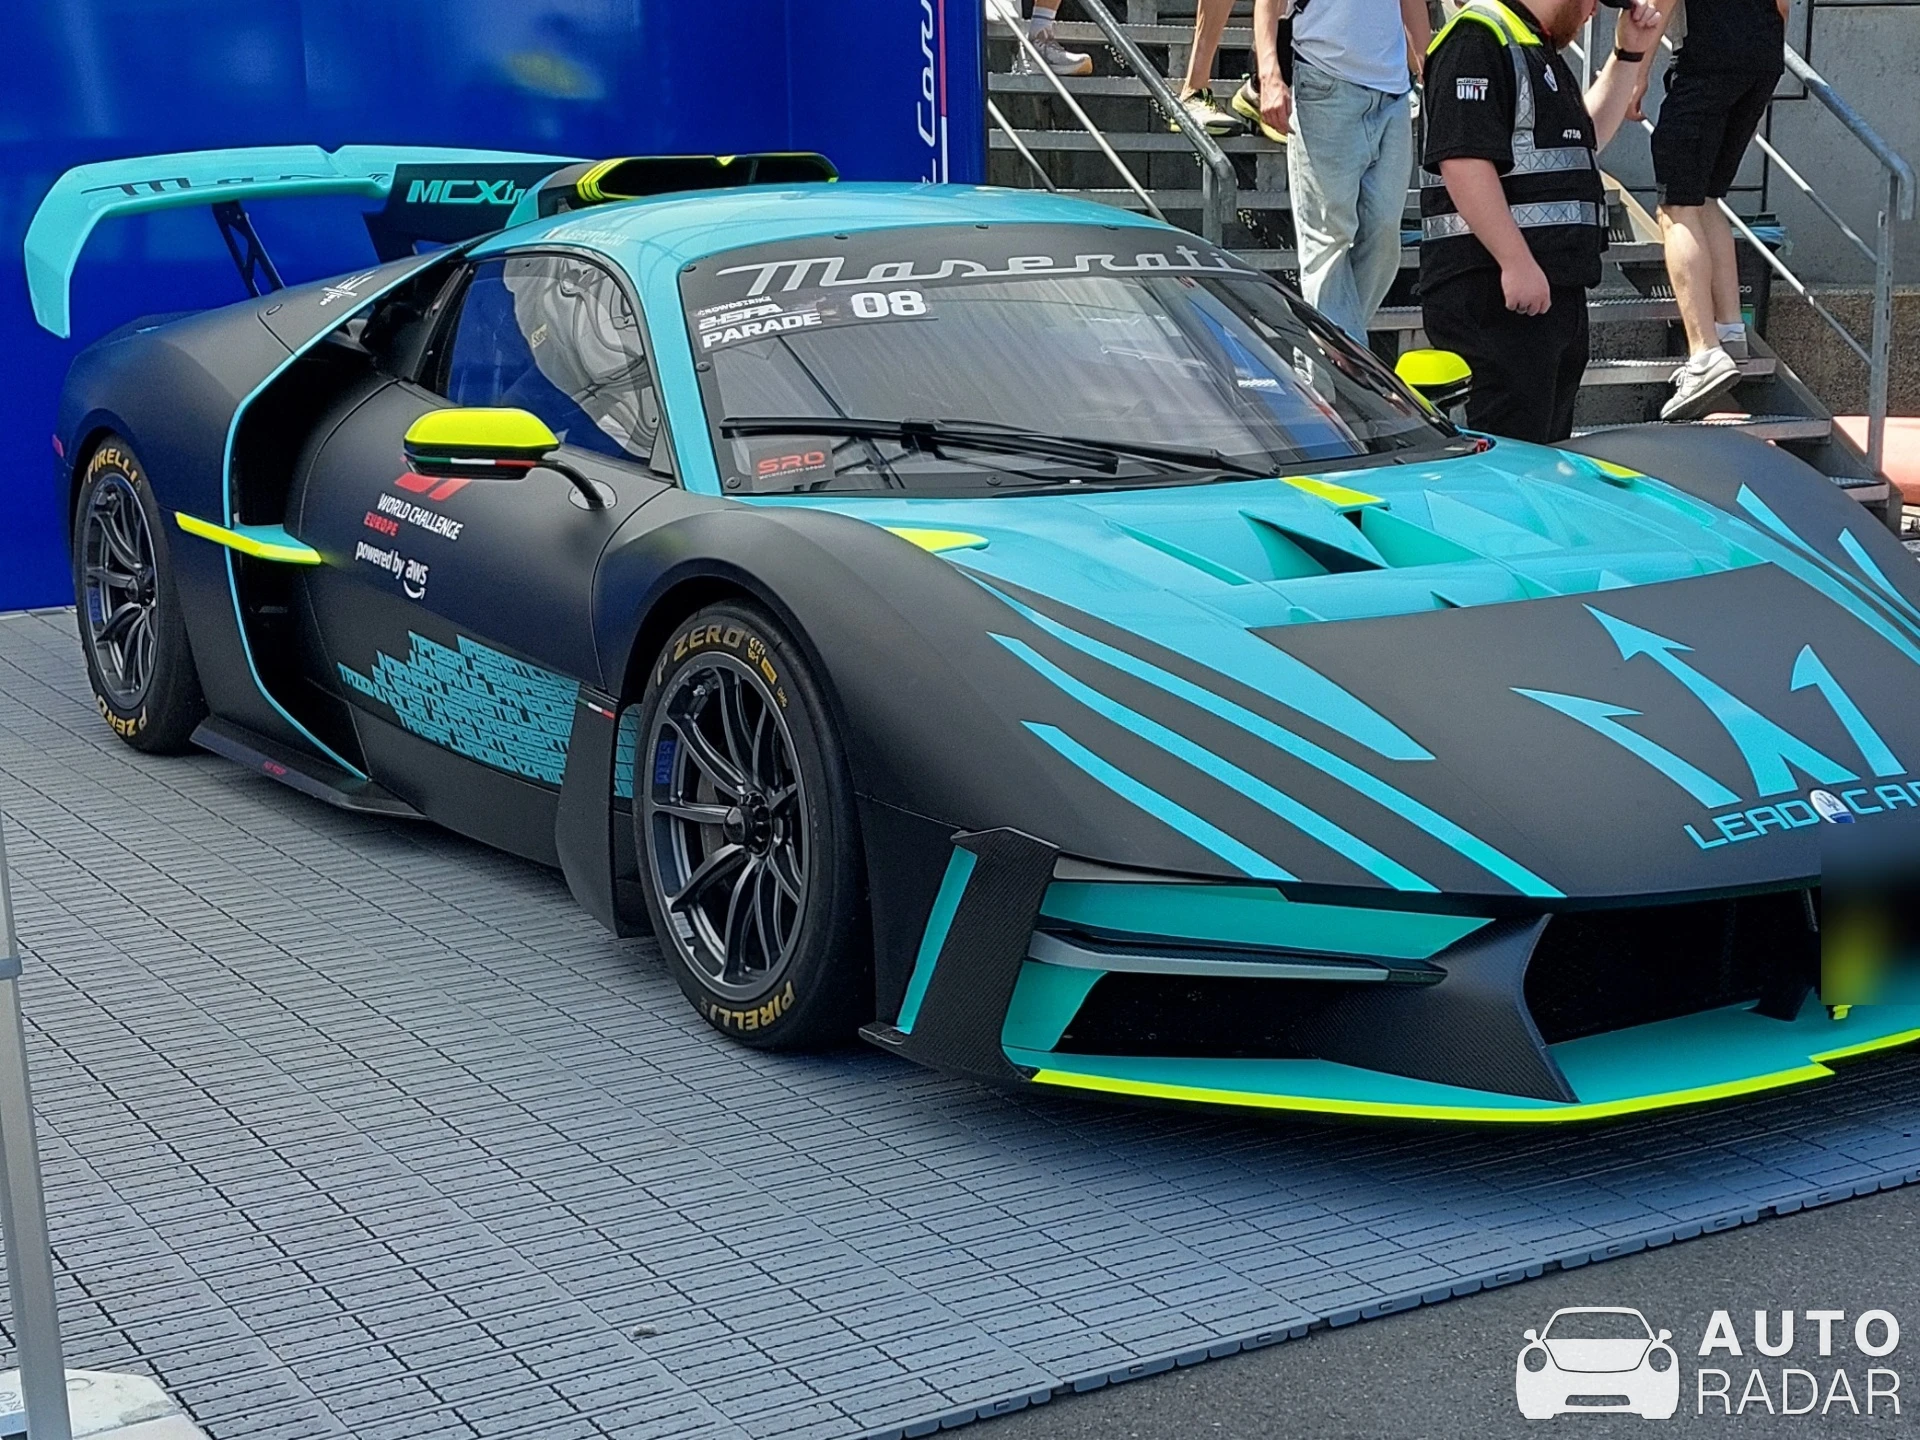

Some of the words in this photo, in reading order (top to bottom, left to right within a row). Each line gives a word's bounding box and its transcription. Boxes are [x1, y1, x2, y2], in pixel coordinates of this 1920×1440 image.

[716, 245, 1258, 297] Maserati
[851, 290, 928, 319] 08
[702, 312, 823, 349] PARADE
[87, 448, 138, 484] PIRELLI
[757, 451, 826, 475] SRO
[364, 511, 399, 536] EUROPE
[377, 493, 411, 520] WORLD
[408, 506, 464, 540] CHALLENGE
[355, 541, 394, 570] powered
[392, 551, 405, 580] by
[405, 559, 429, 585] aws
[673, 624, 746, 662] ZERO
[97, 694, 137, 737] ZERO
[1683, 799, 1821, 850] LEAD
[709, 980, 795, 1031] PIRELLI
